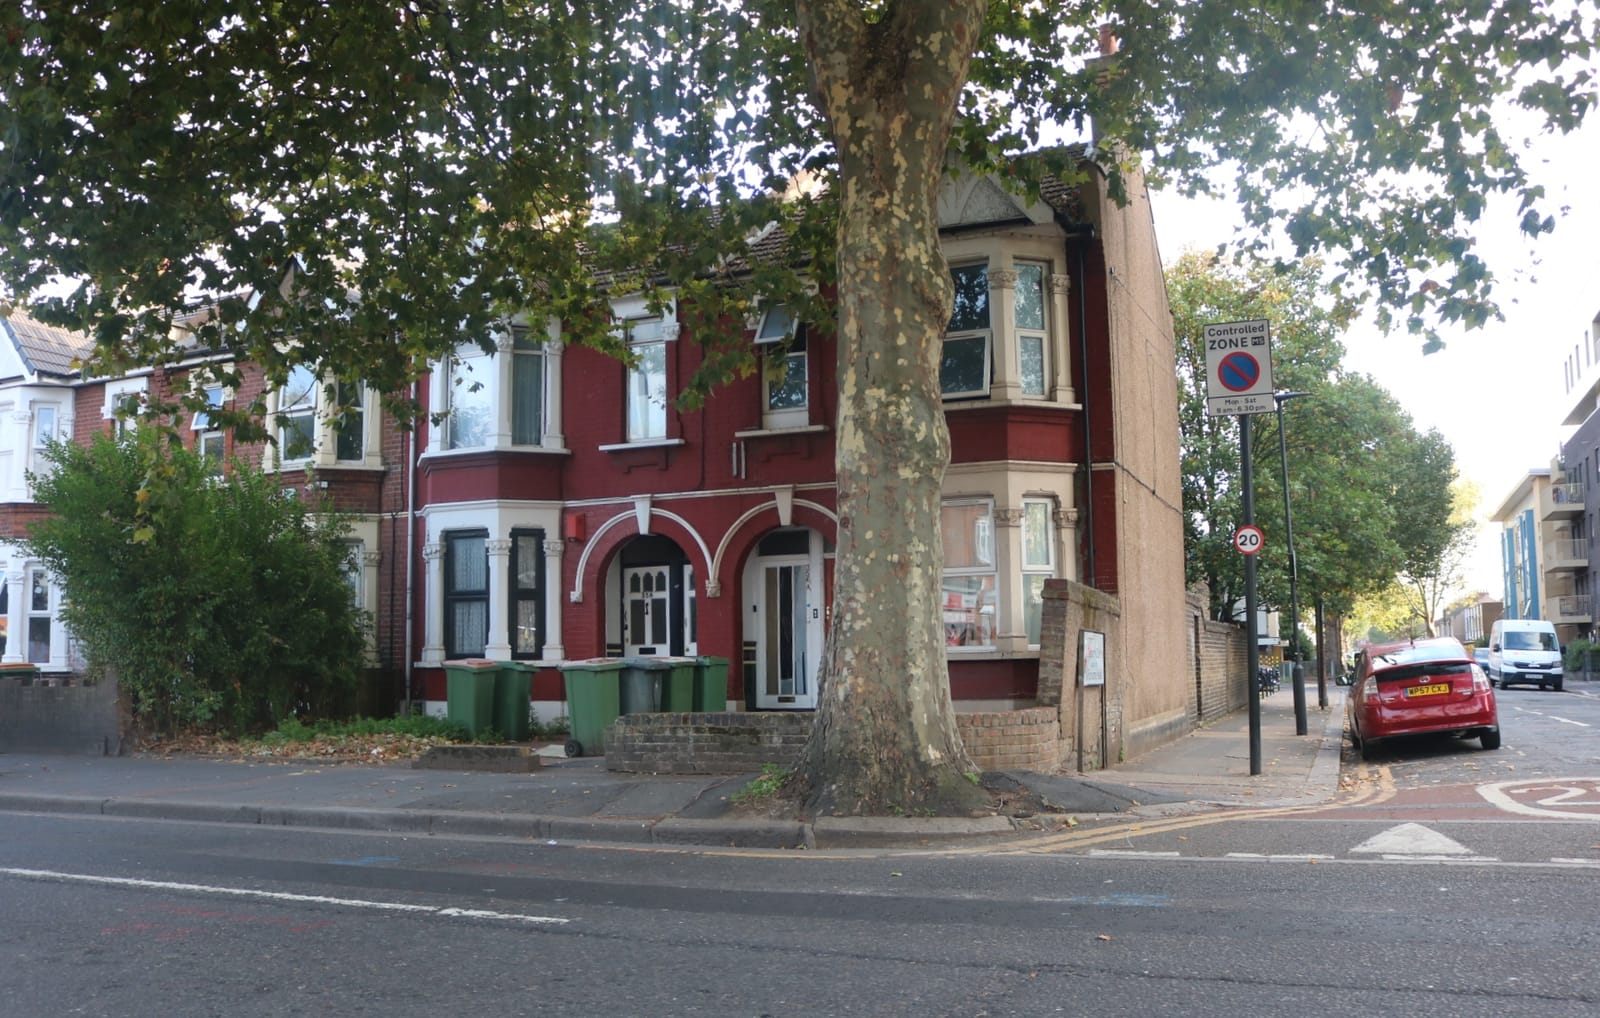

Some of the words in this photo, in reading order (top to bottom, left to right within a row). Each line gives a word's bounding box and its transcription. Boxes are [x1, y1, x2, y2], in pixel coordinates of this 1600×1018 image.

[1208, 324, 1265, 337] Controlled
[1209, 337, 1249, 350] ZONE
[1238, 533, 1259, 546] 20
[1409, 686, 1430, 696] WP57
[1509, 786, 1600, 806] 2
